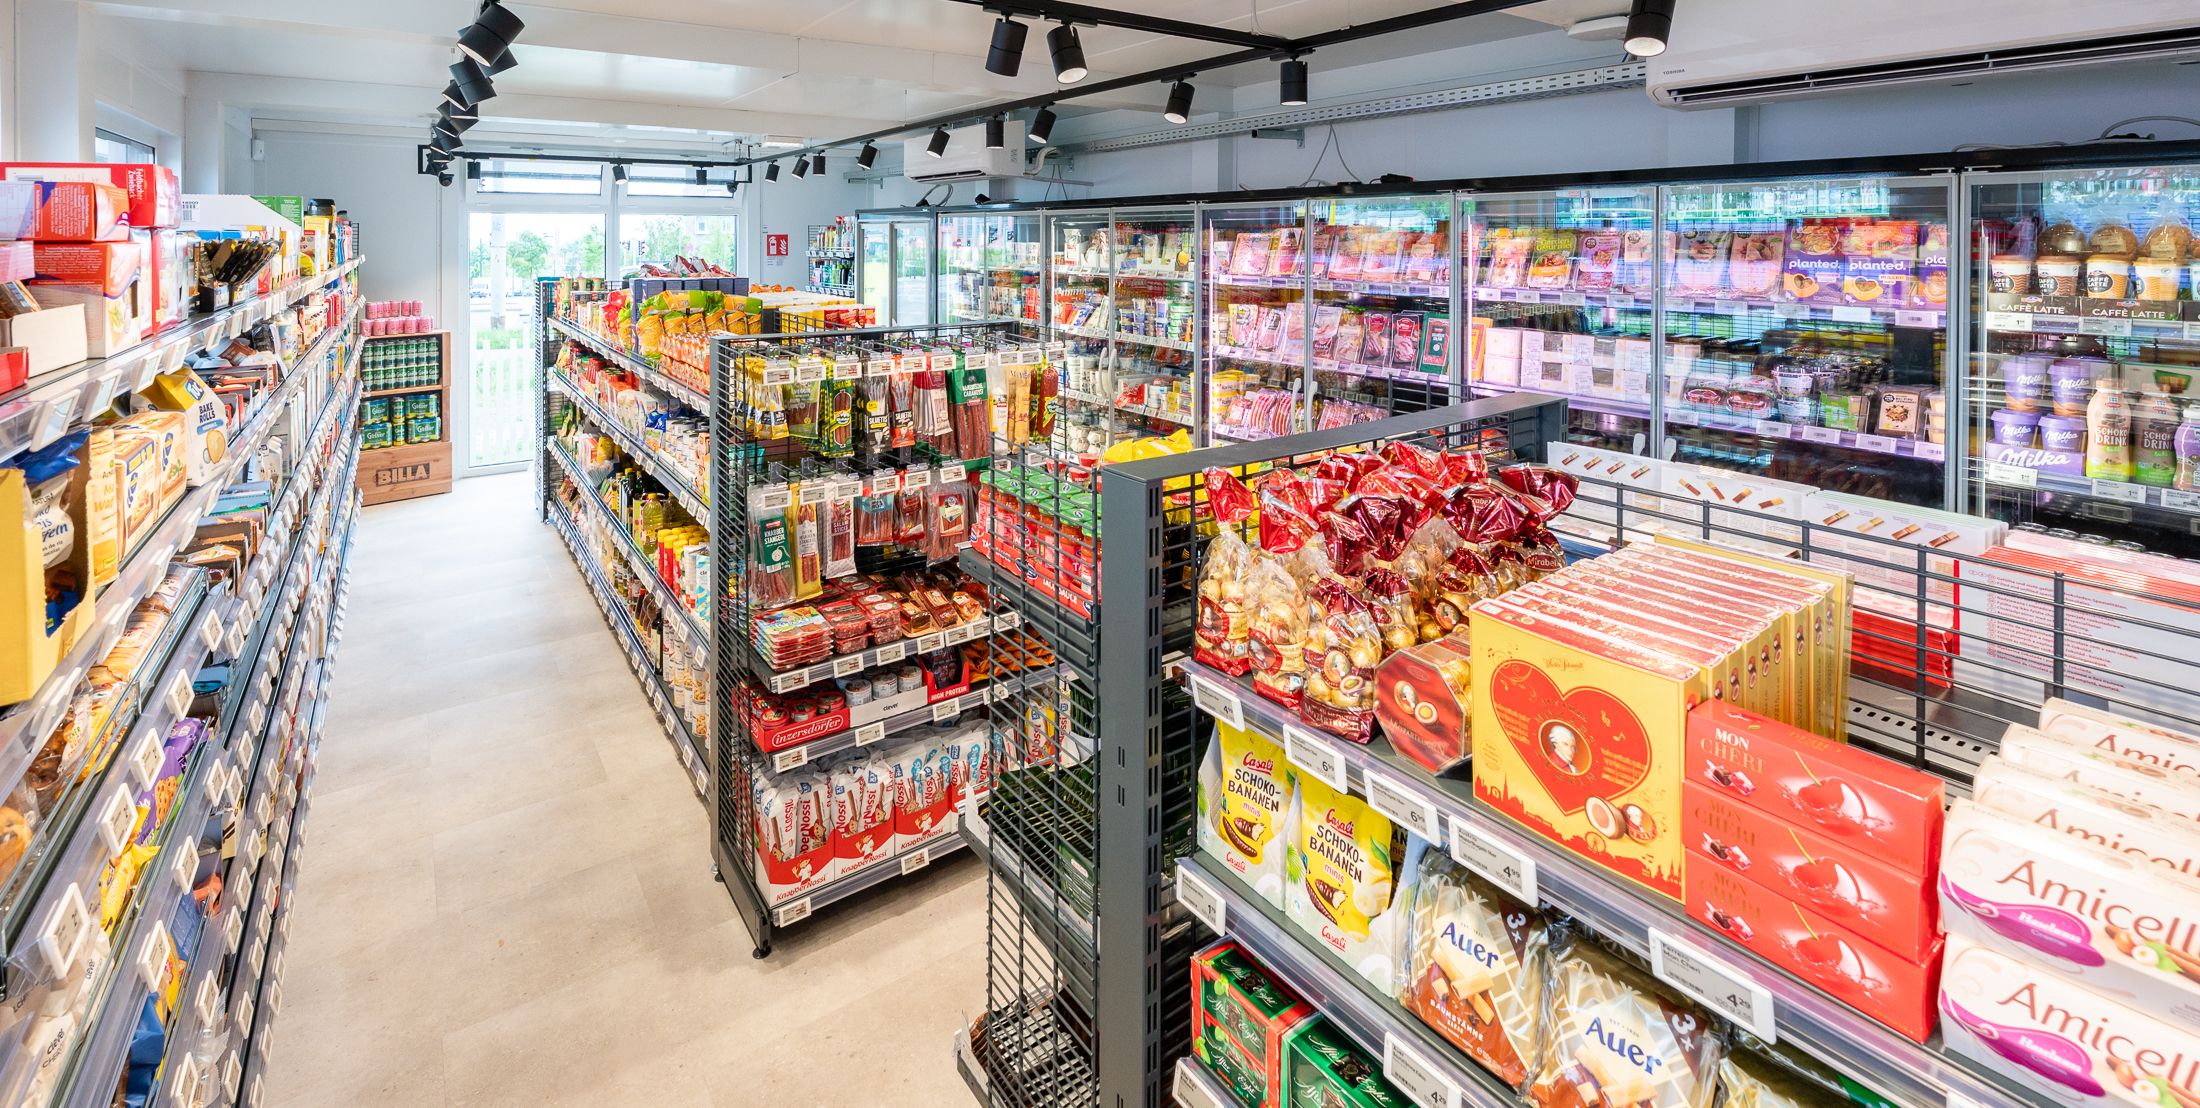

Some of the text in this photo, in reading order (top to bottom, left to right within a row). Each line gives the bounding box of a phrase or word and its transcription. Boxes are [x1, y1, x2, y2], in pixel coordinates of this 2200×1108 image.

[1789, 259, 1840, 270] planted.
[1850, 261, 1906, 271] planted.
[1925, 255, 1947, 266] pla
[2033, 306, 2066, 315] LATTE
[2092, 307, 2166, 320] CAFFÈ LATTE
[199, 402, 214, 414] BAKE
[199, 410, 216, 423] ROLLS
[2000, 425, 2032, 437] Milka
[2045, 430, 2078, 442] Milka
[2096, 434, 2128, 446] DRINK
[1997, 448, 2071, 468] Milka
[378, 464, 429, 486] BILLA
[931, 686, 967, 701] HIGH PROTEIN
[883, 703, 899, 712] clever
[1715, 728, 1749, 749] MON
[1243, 752, 1273, 772] Casali
[1700, 738, 1764, 774] CHERI
[1234, 767, 1281, 797] SCHOKO-
[1227, 780, 1279, 812] BANANEN
[1243, 800, 1262, 818] minis
[1710, 800, 1741, 821] MON
[1326, 808, 1354, 836] Casali
[900, 826, 944, 850] KnabberNossi
[1317, 825, 1364, 863] SCHOKO-
[840, 851, 887, 875] KnabberNossi
[1226, 851, 1246, 872] Casali
[1309, 836, 1362, 883] BANANEN
[1324, 864, 1345, 884] minis
[1714, 872, 1746, 895] MON
[776, 875, 827, 901] KnabberNossi
[1506, 913, 1527, 929] 3
[1321, 925, 1347, 948] Casali
[1441, 922, 1499, 969] Auer
[1429, 999, 1484, 1042] BAUMSTÄMME
[1671, 1014, 1696, 1035] 3
[1585, 1016, 1662, 1076] Auer
